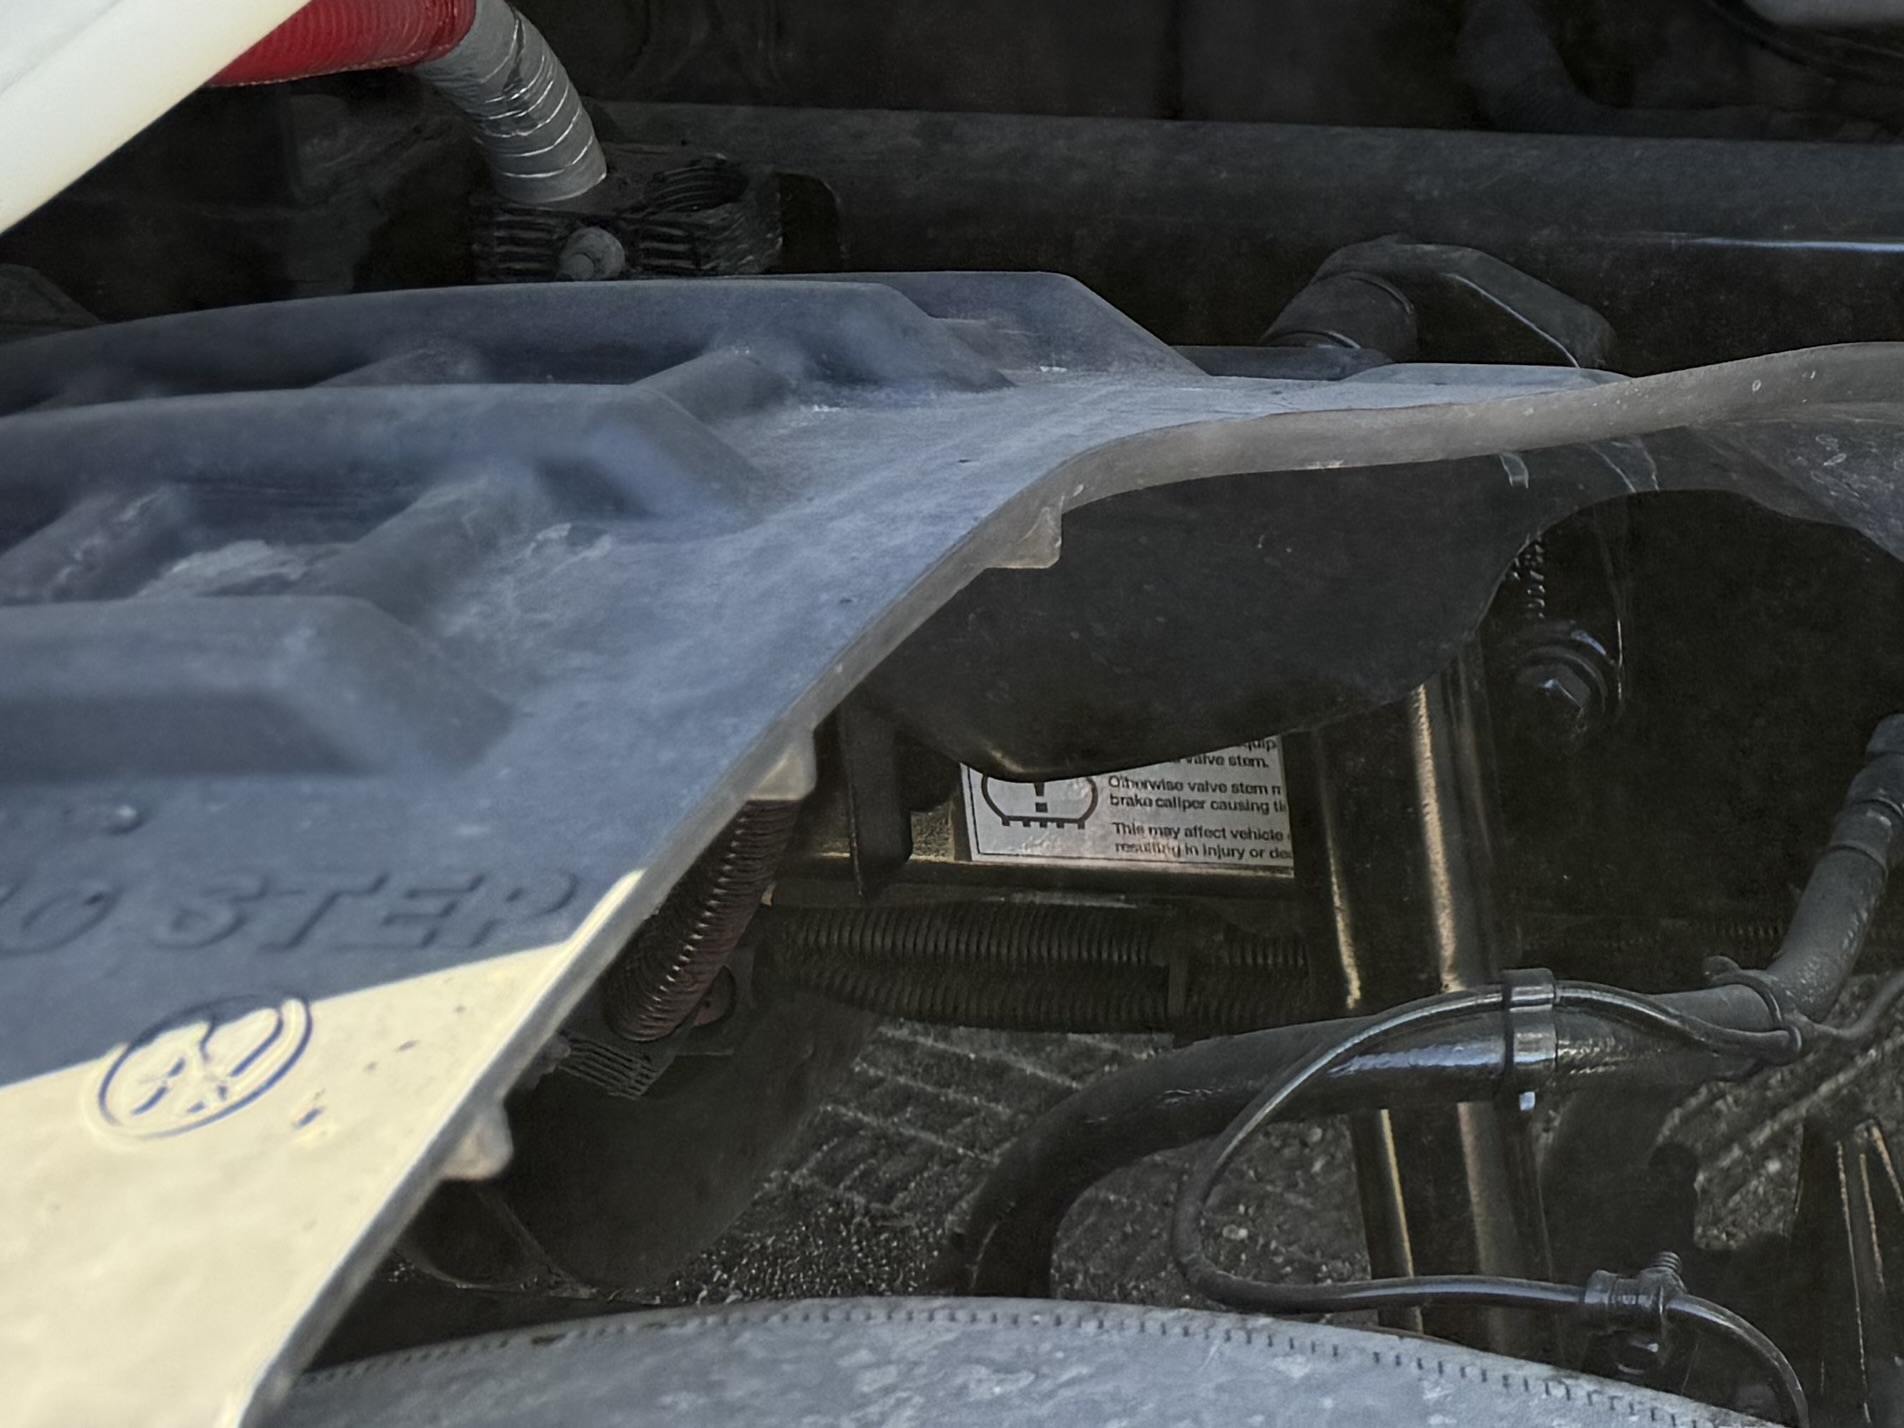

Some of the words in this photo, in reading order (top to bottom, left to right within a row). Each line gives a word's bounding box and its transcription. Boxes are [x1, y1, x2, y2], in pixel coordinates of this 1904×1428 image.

[1228, 758, 1269, 769] stem.
[1108, 775, 1183, 792] Otherwise
[1187, 781, 1227, 794] valve
[1231, 784, 1267, 795] stem
[1109, 795, 1152, 808] brake
[1155, 798, 1206, 813] caliper
[1210, 801, 1270, 815] causing
[1112, 822, 1145, 836] This
[1149, 826, 1181, 839] may
[1184, 826, 1227, 839] affect
[1230, 828, 1284, 842] vehicle
[1185, 843, 1199, 857] in
[1202, 845, 1244, 860] injury
[1249, 848, 1266, 859] or
[150, 871, 581, 952] STEP
